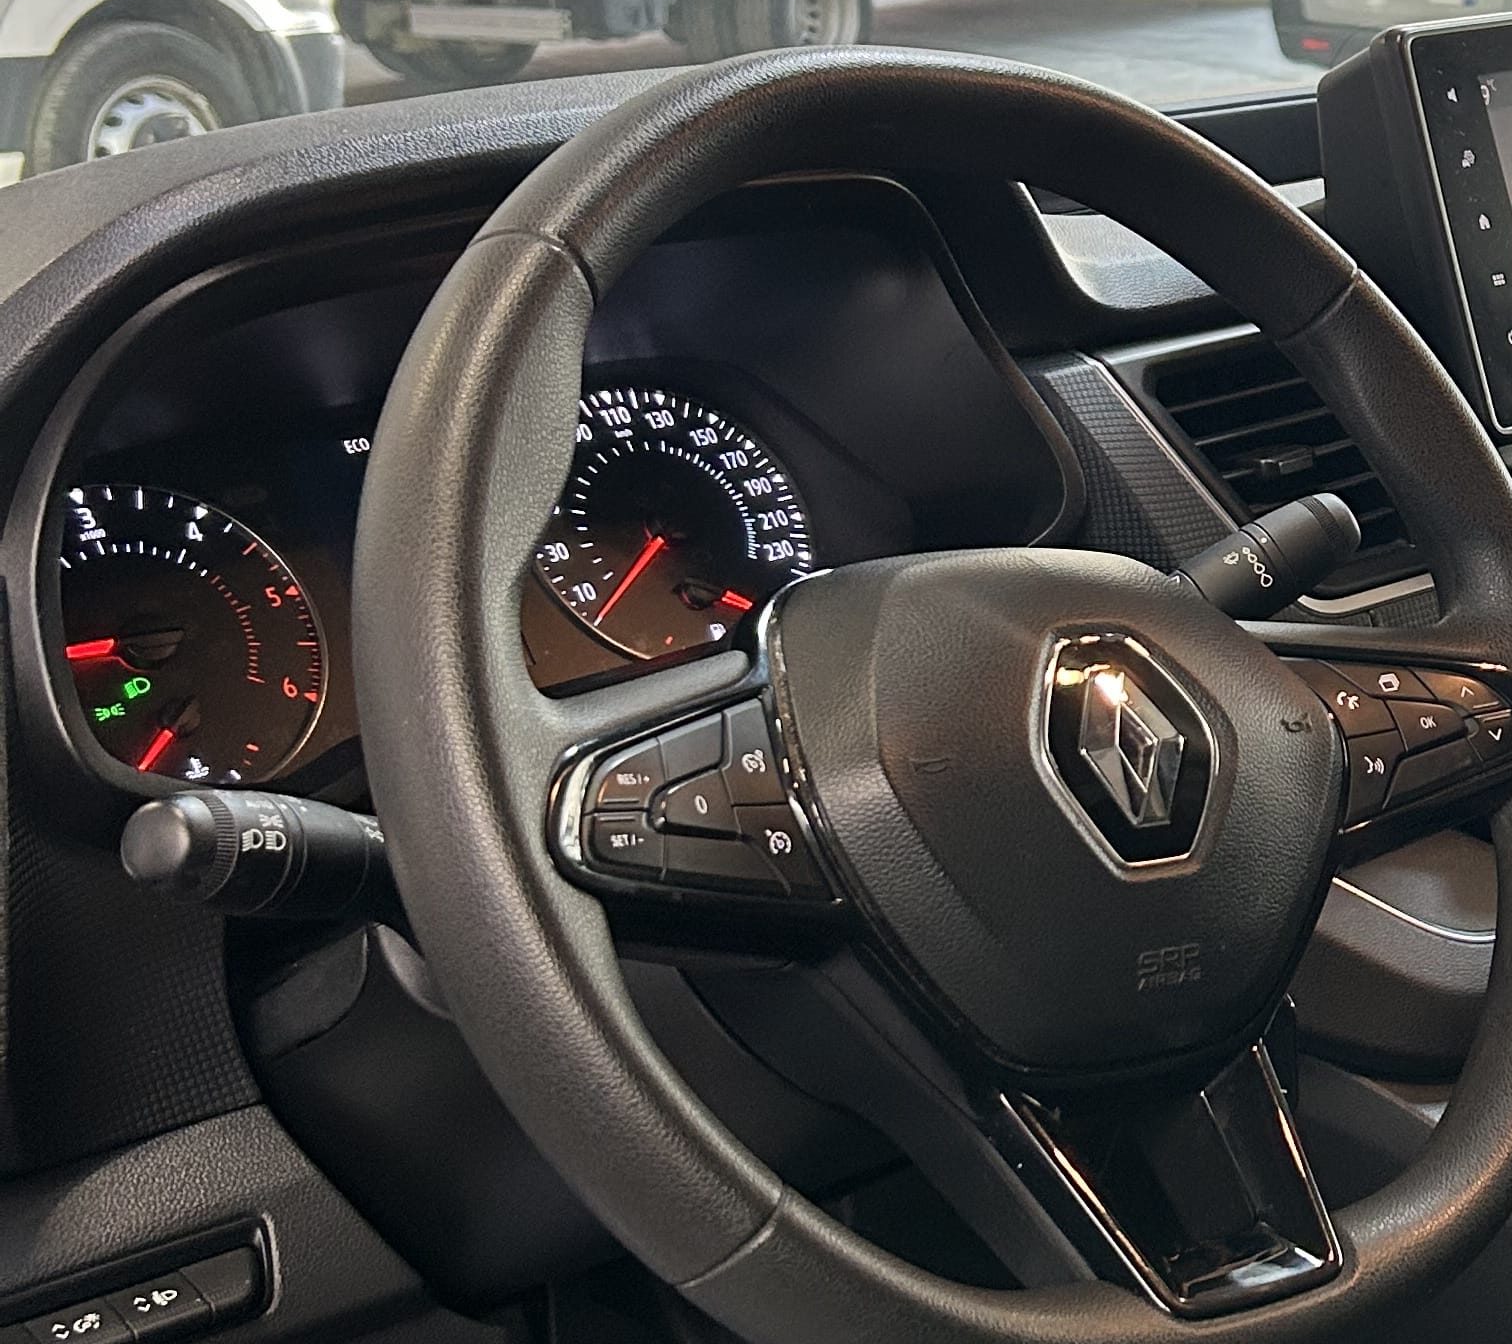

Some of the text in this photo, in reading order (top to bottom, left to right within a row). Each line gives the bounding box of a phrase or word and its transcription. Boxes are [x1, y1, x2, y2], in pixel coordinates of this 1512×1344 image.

[600, 406, 632, 427] 110
[645, 409, 674, 429] 130
[343, 437, 370, 454] ECO
[689, 427, 718, 447] 150
[719, 449, 749, 470] 170
[743, 476, 772, 497] 190
[75, 507, 96, 529] 3
[758, 509, 789, 531] 210
[186, 521, 203, 542] 4
[544, 542, 570, 563] 30
[763, 539, 794, 562] 230
[264, 586, 282, 607] 5
[572, 582, 597, 603] 10
[283, 676, 298, 697] 6
[1419, 716, 1438, 730] OK
[1136, 942, 1201, 976] SRP
